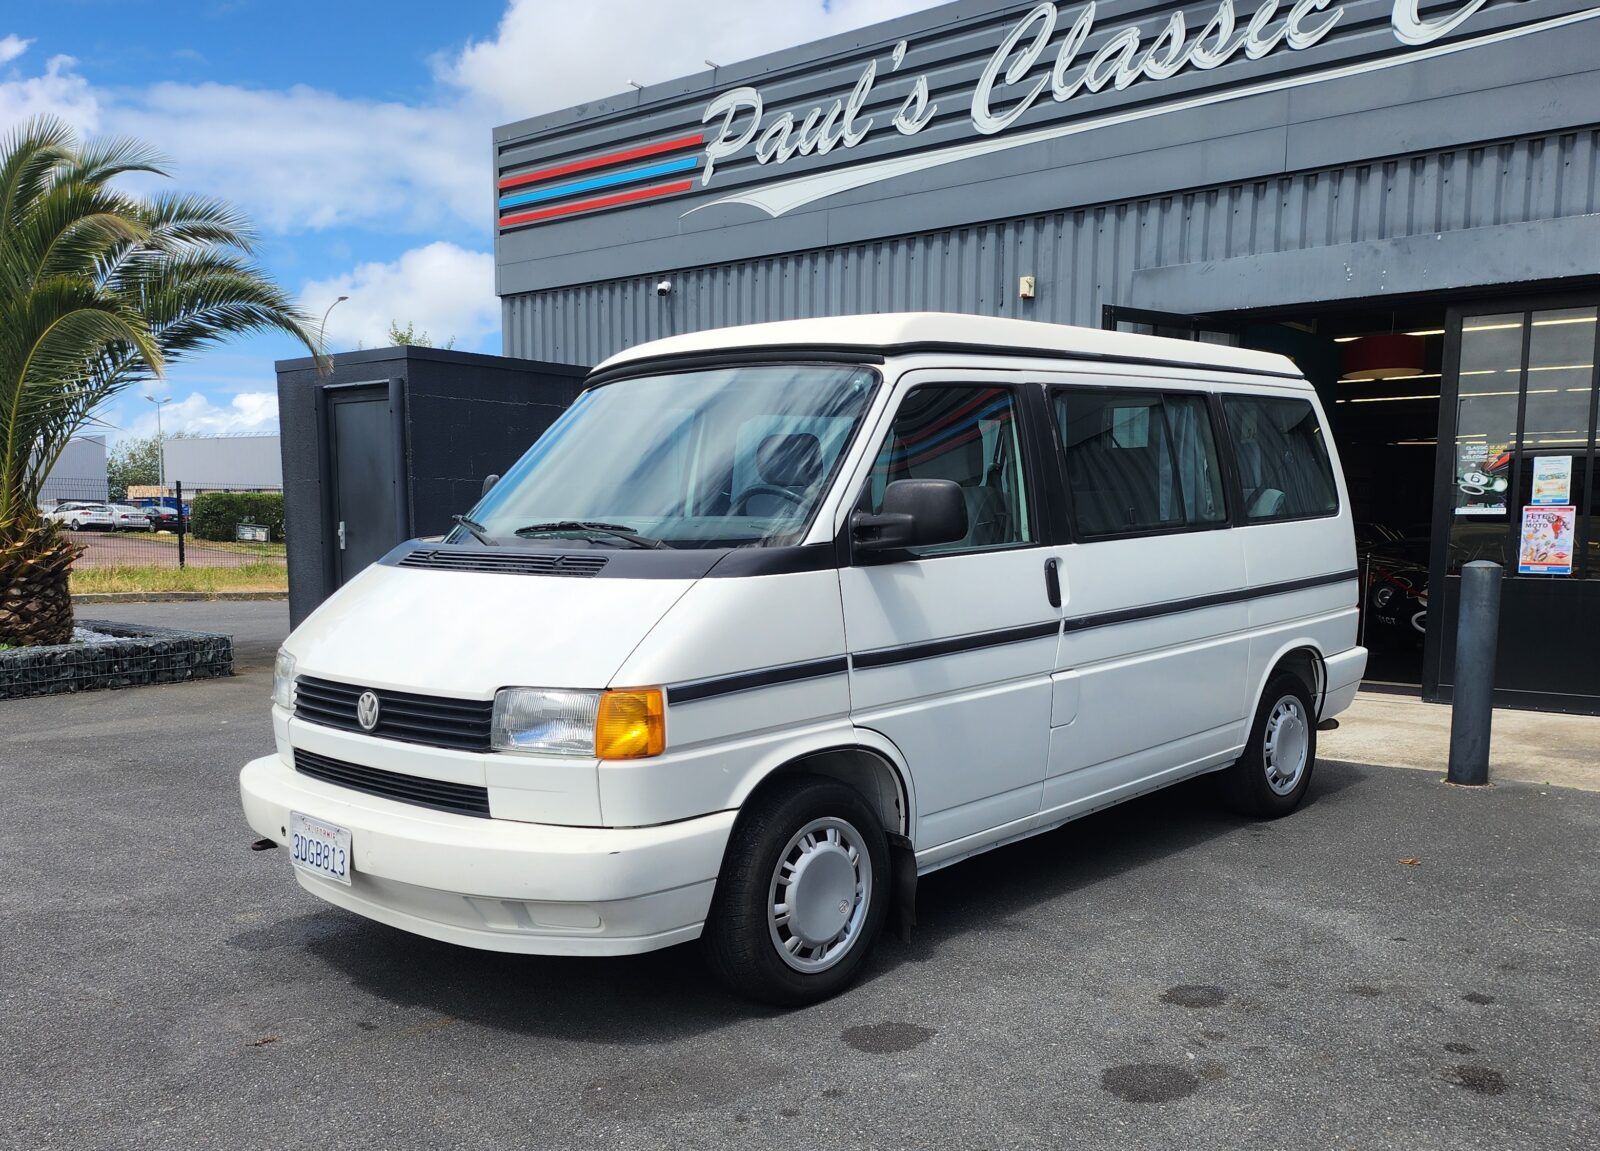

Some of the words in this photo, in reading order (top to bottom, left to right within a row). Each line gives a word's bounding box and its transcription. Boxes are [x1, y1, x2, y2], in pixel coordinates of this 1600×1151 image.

[702, 40, 938, 187] Paul's
[971, 0, 1344, 134] Classic
[293, 833, 346, 876] 3DGB813
